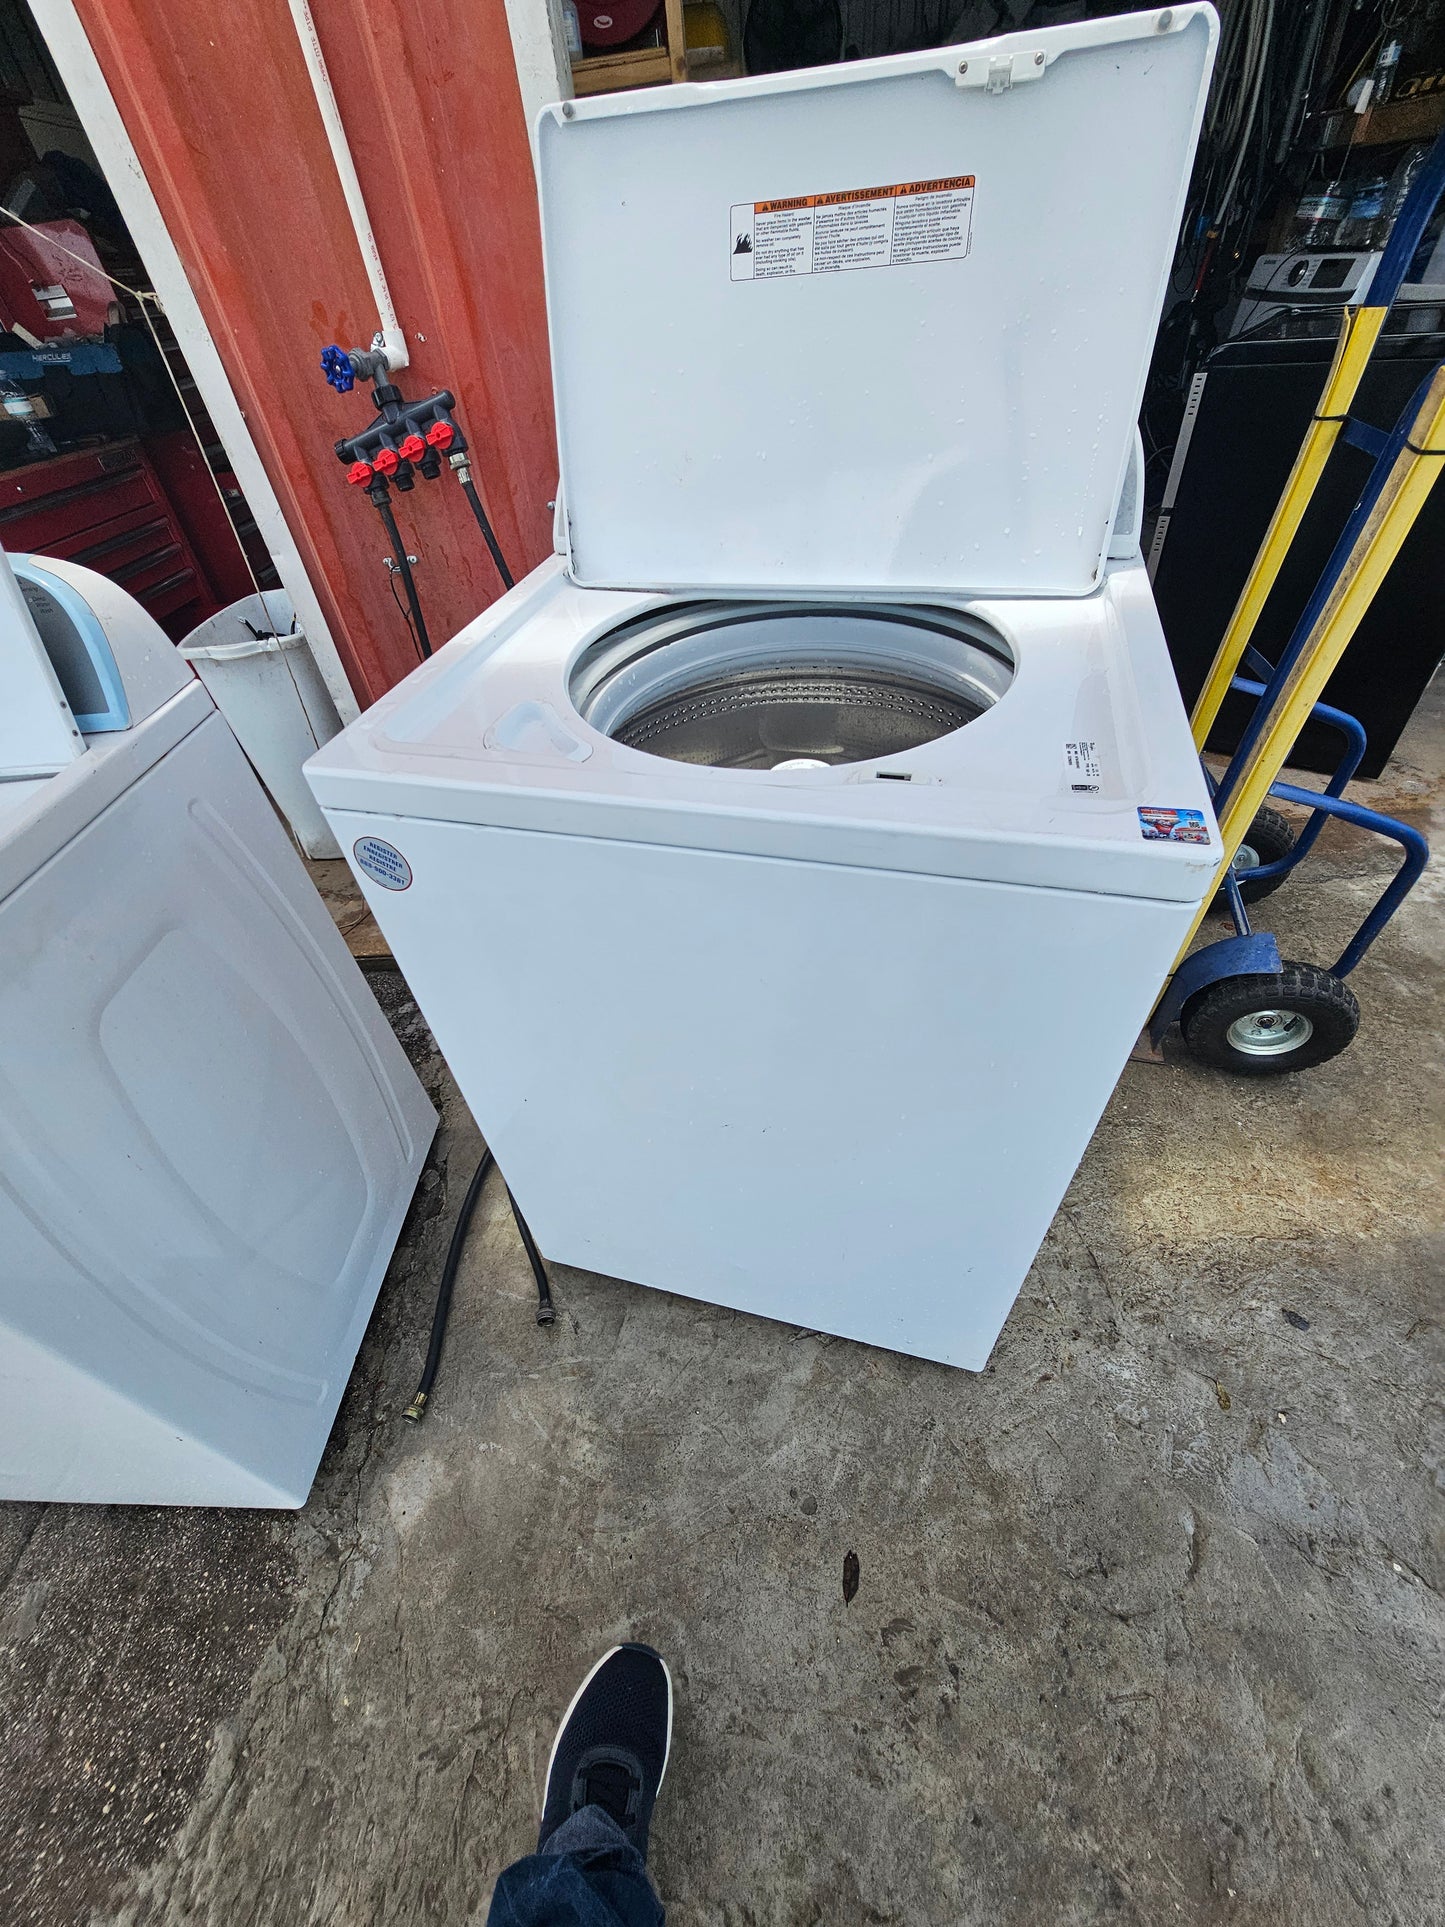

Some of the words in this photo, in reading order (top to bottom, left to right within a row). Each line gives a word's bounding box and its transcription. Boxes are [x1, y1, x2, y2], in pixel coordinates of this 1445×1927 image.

[909, 177, 970, 193] ADVERTENCIA
[825, 187, 893, 203] AVERTISSEMENT
[770, 198, 807, 210] WARNING
[370, 842, 397, 859] REGISTER
